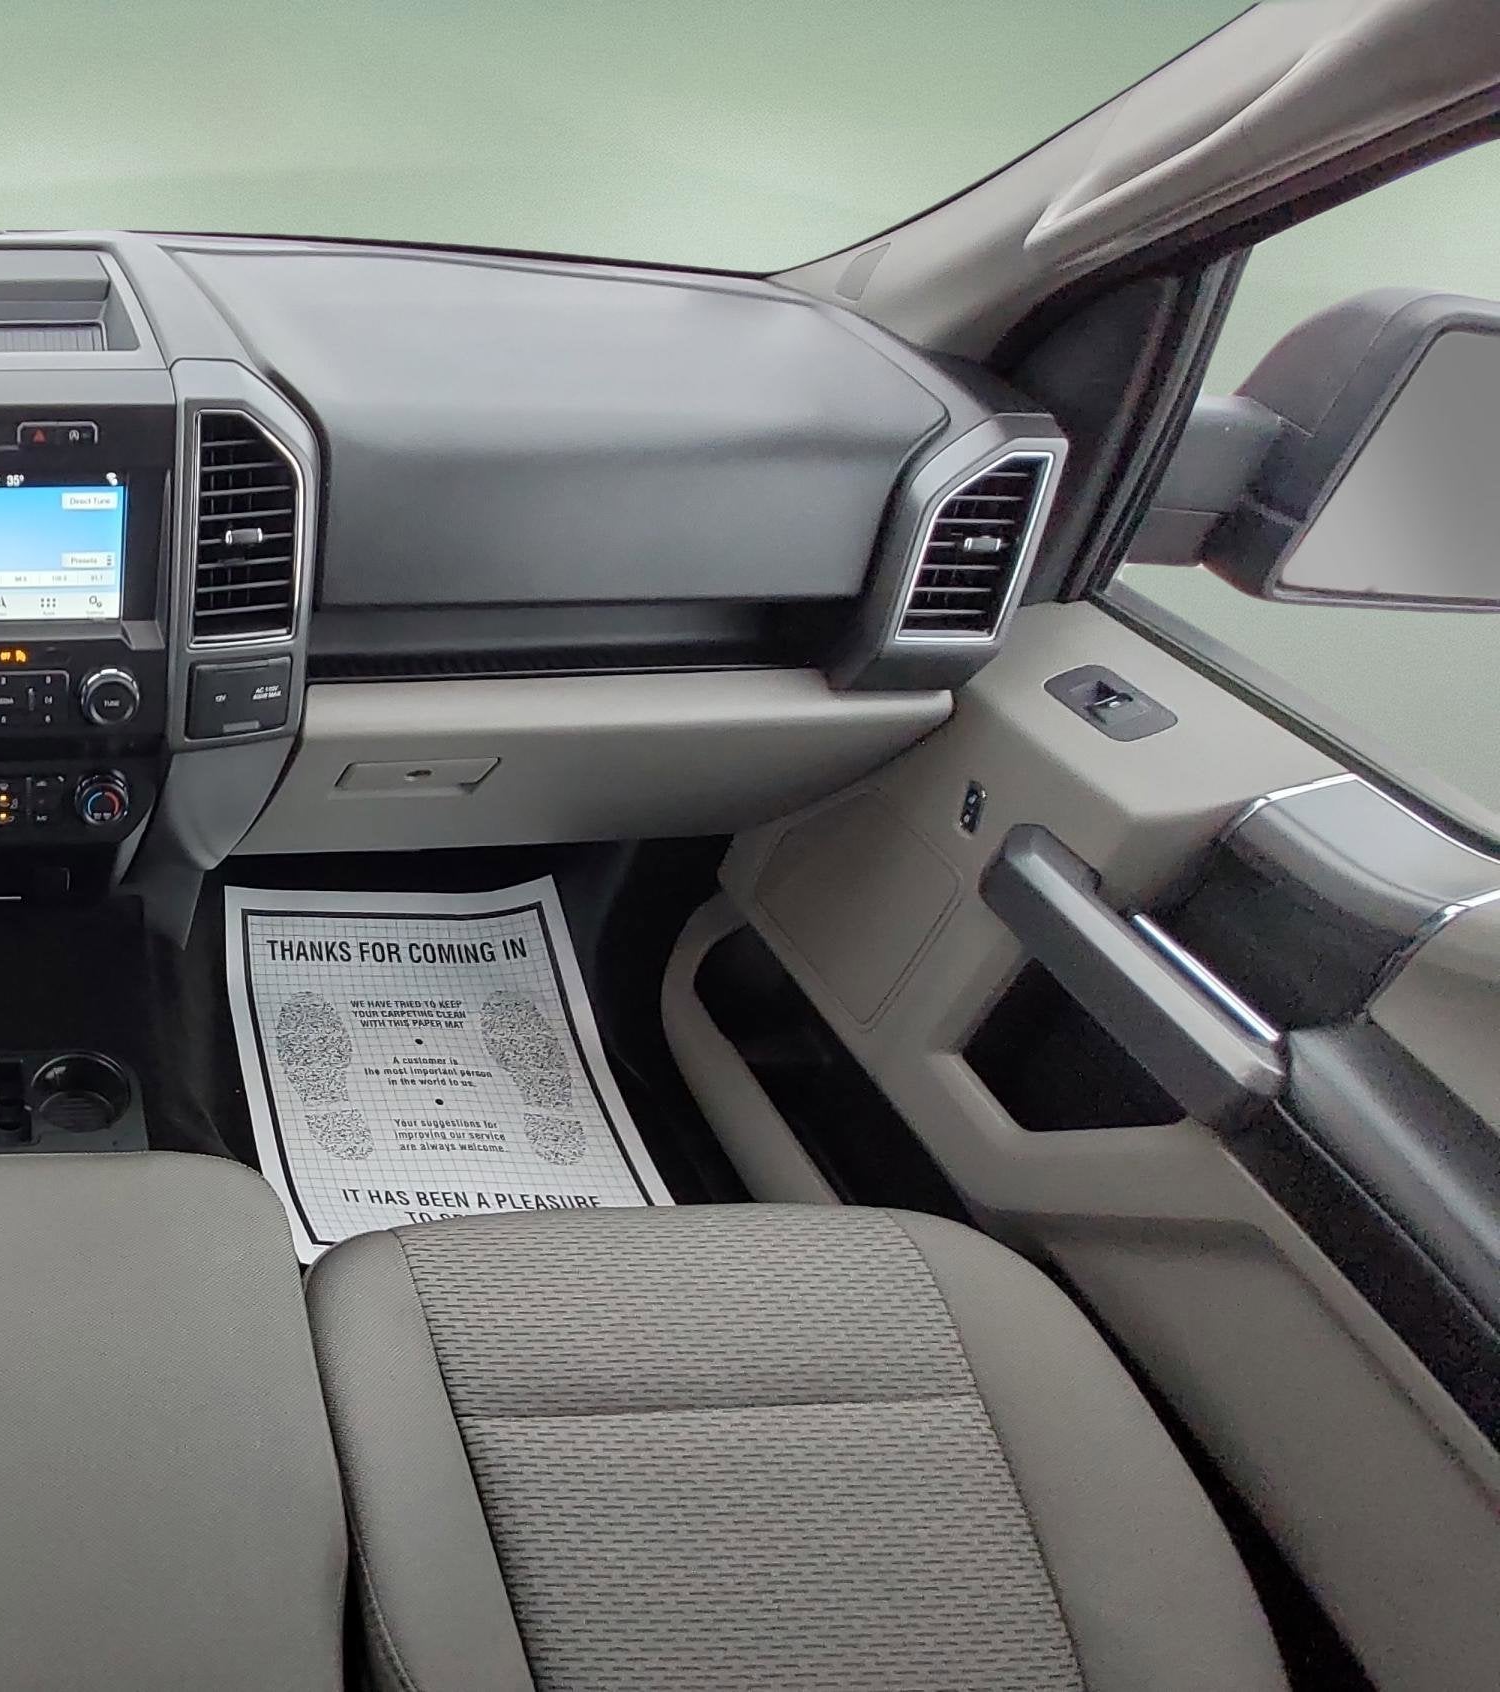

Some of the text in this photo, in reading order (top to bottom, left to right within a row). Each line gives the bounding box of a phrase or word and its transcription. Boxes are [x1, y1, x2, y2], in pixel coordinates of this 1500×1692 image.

[69, 497, 91, 505] Direct
[266, 937, 528, 964] THANKS FOR COMING IN
[350, 1000, 462, 1008] WE HAVE TRIED TO KEEP
[352, 1010, 379, 1018] YOUR
[380, 1010, 434, 1018] CARPETING
[360, 1020, 464, 1028] WITH THIS PAPER MAT
[392, 1056, 458, 1065] A customer is
[364, 1066, 492, 1078] the most important person
[388, 1077, 397, 1085] in
[419, 1077, 446, 1086] world
[449, 1078, 459, 1086] to
[393, 1119, 498, 1129] Your suggestions for
[394, 1130, 446, 1140] improving
[468, 1131, 506, 1141] service
[400, 1143, 416, 1151] are
[419, 1142, 456, 1152] always
[342, 1189, 601, 1210] IT HAS BEEN A PLEASURE
